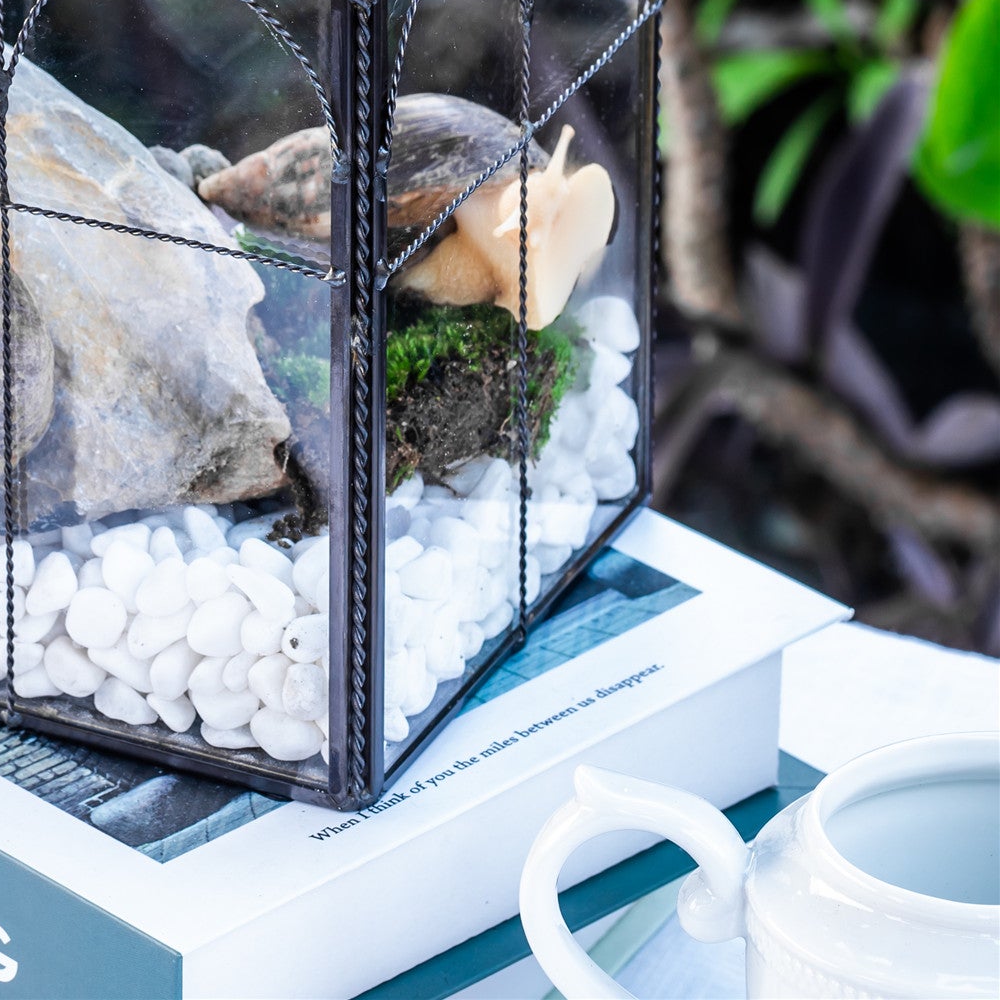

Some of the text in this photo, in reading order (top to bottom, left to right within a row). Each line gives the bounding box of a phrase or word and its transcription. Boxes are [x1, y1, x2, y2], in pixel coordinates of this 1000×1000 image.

[309, 816, 361, 841] When
[367, 793, 411, 815] think
[409, 780, 428, 794] of
[425, 769, 456, 787] you
[452, 756, 480, 771] the
[480, 735, 519, 758] miles
[514, 706, 579, 738] between
[577, 697, 596, 708] us
[594, 664, 664, 698] disappear.
